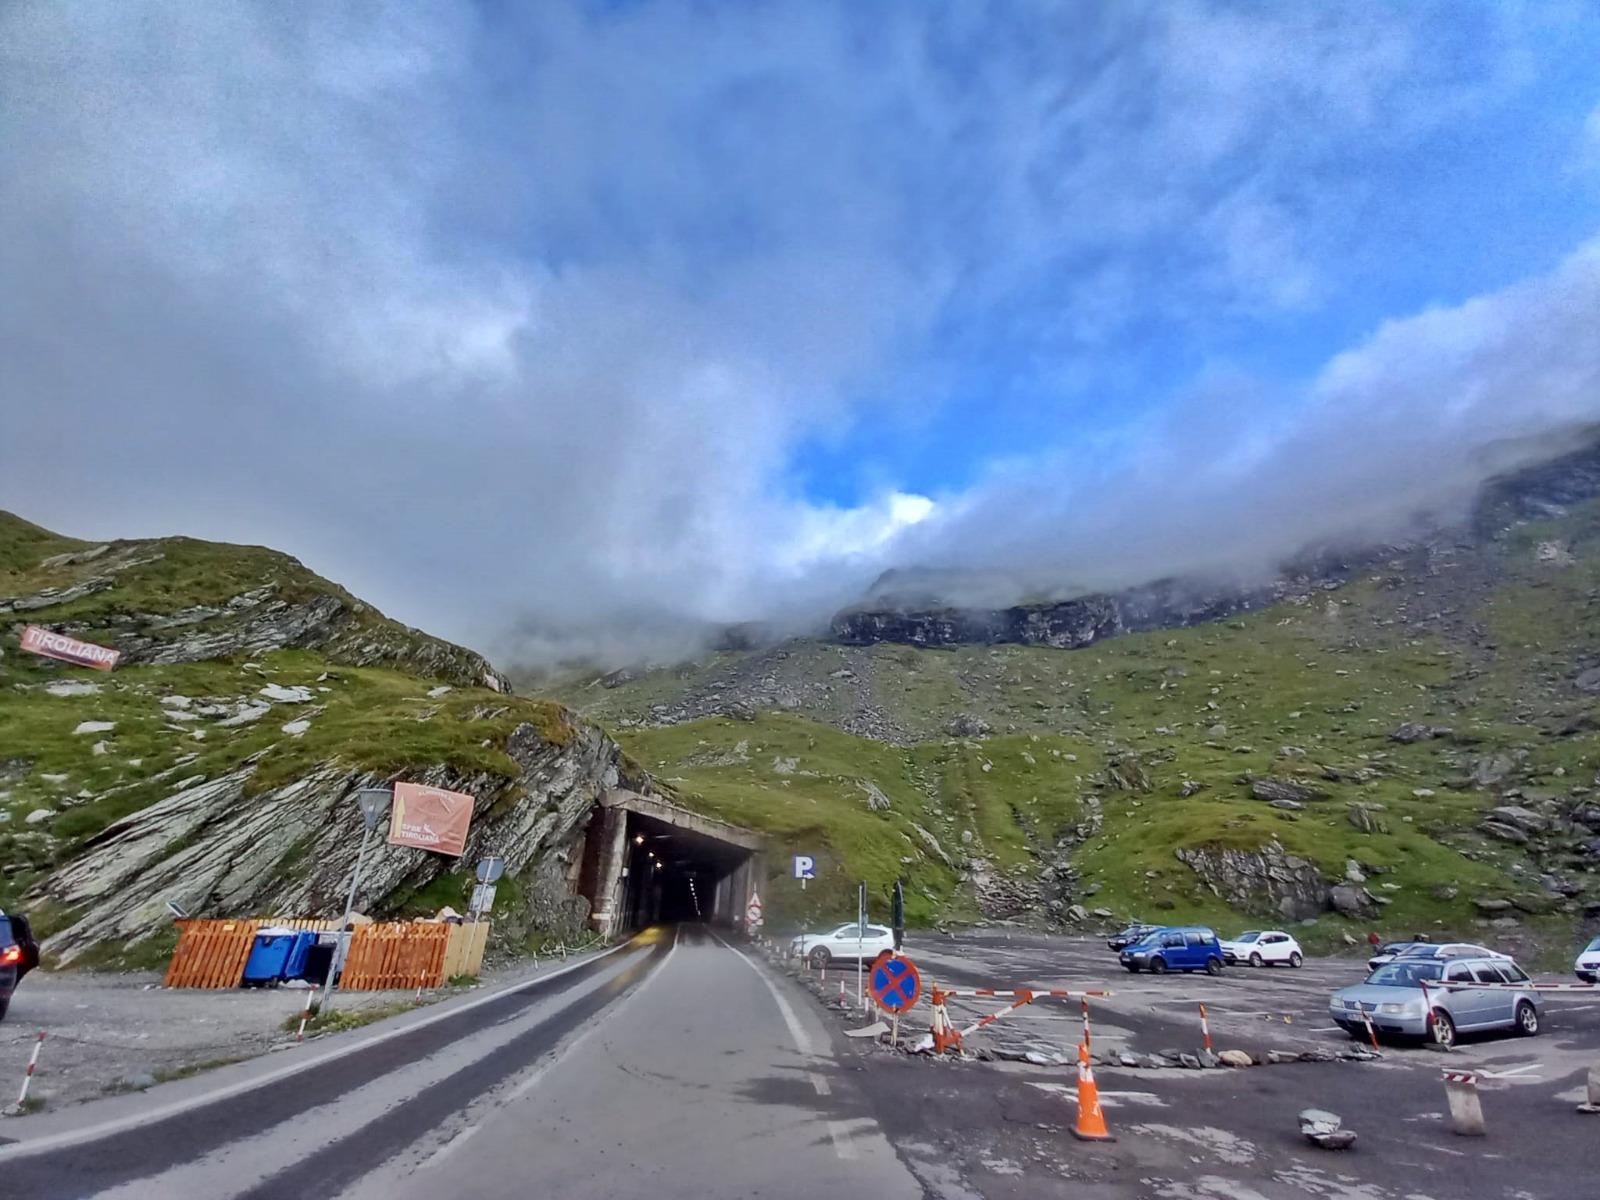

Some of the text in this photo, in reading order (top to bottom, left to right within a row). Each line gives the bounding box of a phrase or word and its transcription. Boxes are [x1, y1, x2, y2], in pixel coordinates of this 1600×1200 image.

[28, 629, 115, 664] TIROLIANA
[401, 831, 440, 843] TIROLIANA
[795, 856, 813, 878] P
